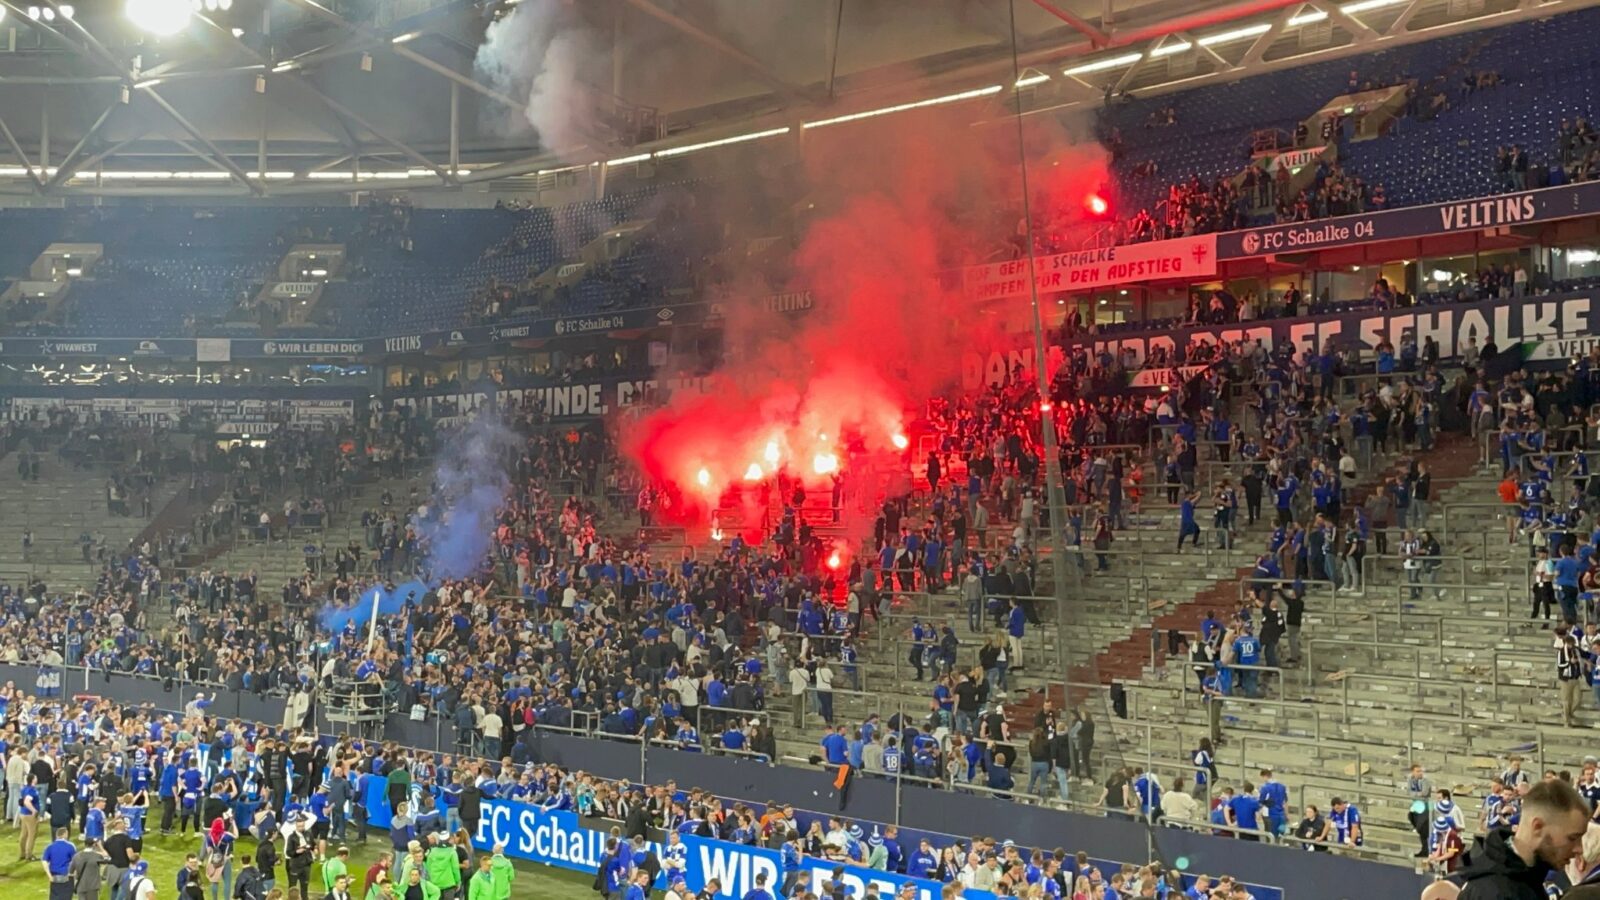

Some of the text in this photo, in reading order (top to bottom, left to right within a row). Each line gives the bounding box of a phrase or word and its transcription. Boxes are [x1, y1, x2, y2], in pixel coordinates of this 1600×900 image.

[1440, 195, 1536, 230] VELTINS
[1263, 220, 1375, 249] FC Schalke 04
[1053, 248, 1115, 269] SCHALKE
[1070, 268, 1100, 283] DEN
[1107, 257, 1182, 280] AUFSTIEG
[500, 326, 530, 338] VIVAWEST
[566, 321, 578, 332] FC
[579, 317, 611, 331] Schalke
[1360, 298, 1590, 366] SCHALKE
[56, 343, 98, 352] VIVAWEST
[278, 343, 364, 354] WIR LEBEN DICH
[385, 335, 421, 352] VELTINS
[1526, 485, 1533, 497] 6
[1241, 642, 1254, 654] 10
[886, 755, 898, 769] 18
[475, 802, 511, 848] FC
